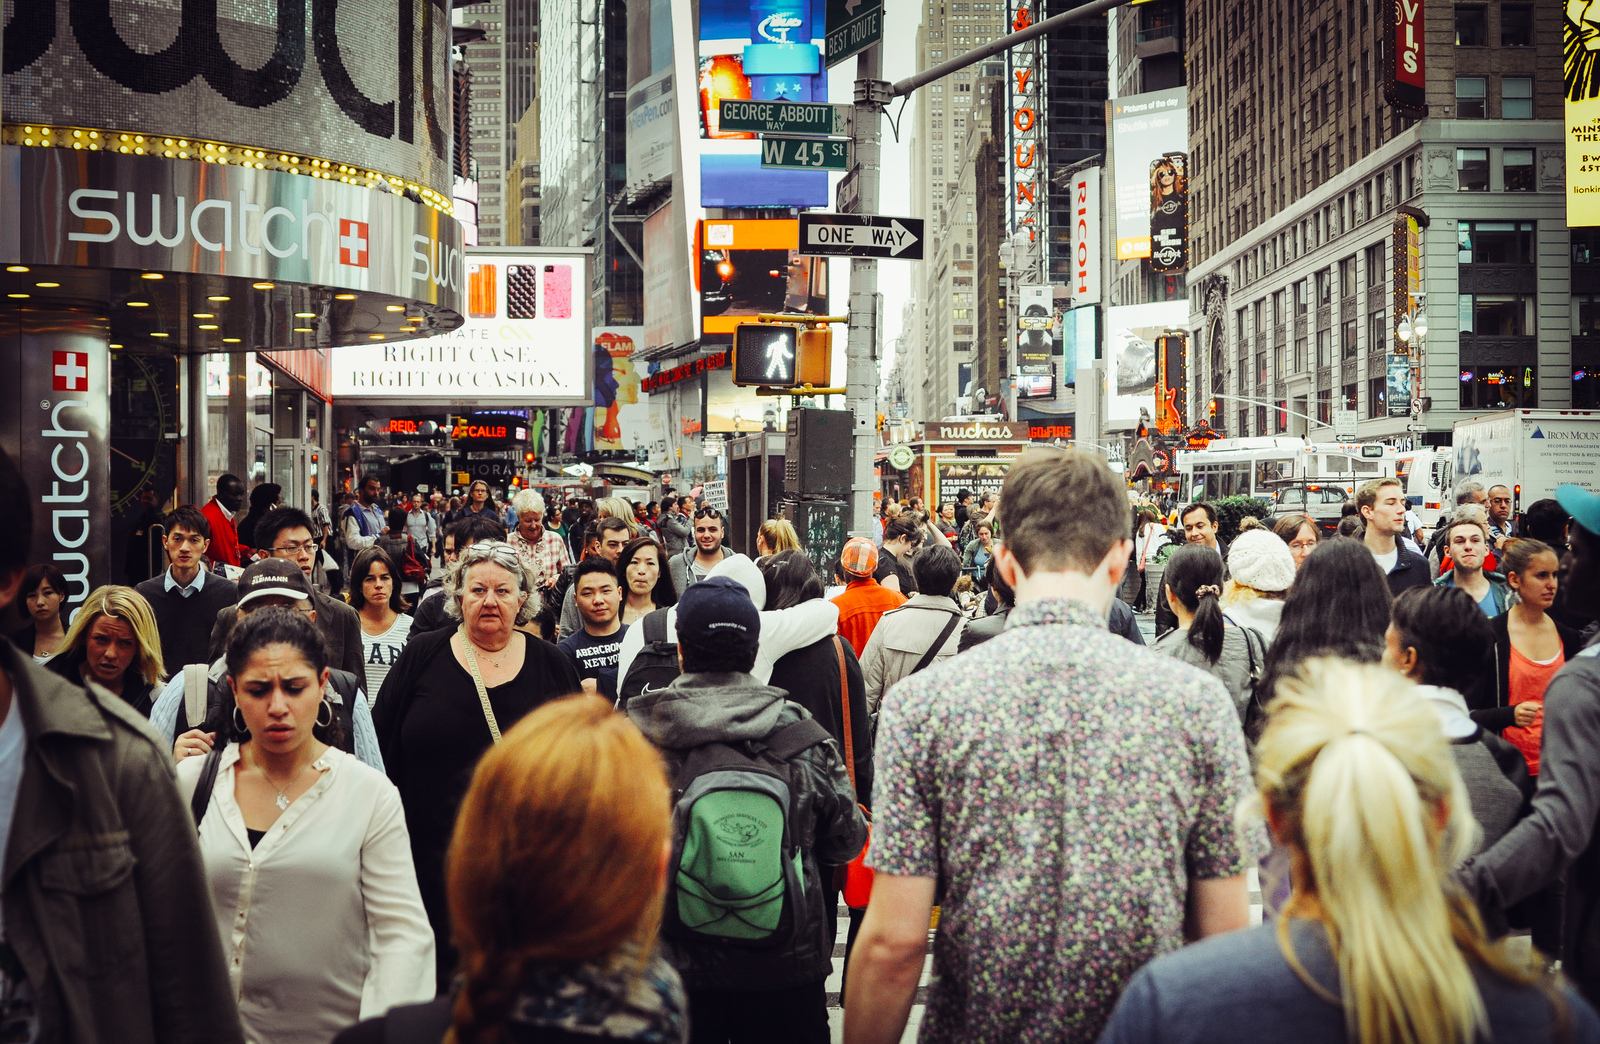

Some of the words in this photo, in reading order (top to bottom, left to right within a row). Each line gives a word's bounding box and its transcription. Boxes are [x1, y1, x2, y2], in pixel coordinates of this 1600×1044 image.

[828, 29, 848, 57] BEST
[850, 13, 877, 44] ROUTE
[1167, 98, 1179, 107] day
[723, 103, 774, 121] GEORGE
[779, 106, 828, 123] ABBOTT
[766, 121, 785, 130] WAY
[763, 140, 786, 164] W
[794, 142, 825, 167] 45
[831, 143, 844, 156] St
[68, 188, 332, 261] swatch
[817, 227, 854, 243] ONE
[872, 229, 906, 246] WAY
[1077, 181, 1087, 293] RICOH
[384, 346, 461, 363] RIGHT
[352, 371, 430, 387] RIGHT
[437, 371, 568, 388] OCCASION.
[940, 423, 1013, 439] nuchas
[1547, 431, 1569, 440] IRON
[41, 401, 90, 625] watch
[583, 657, 607, 669] NEW
